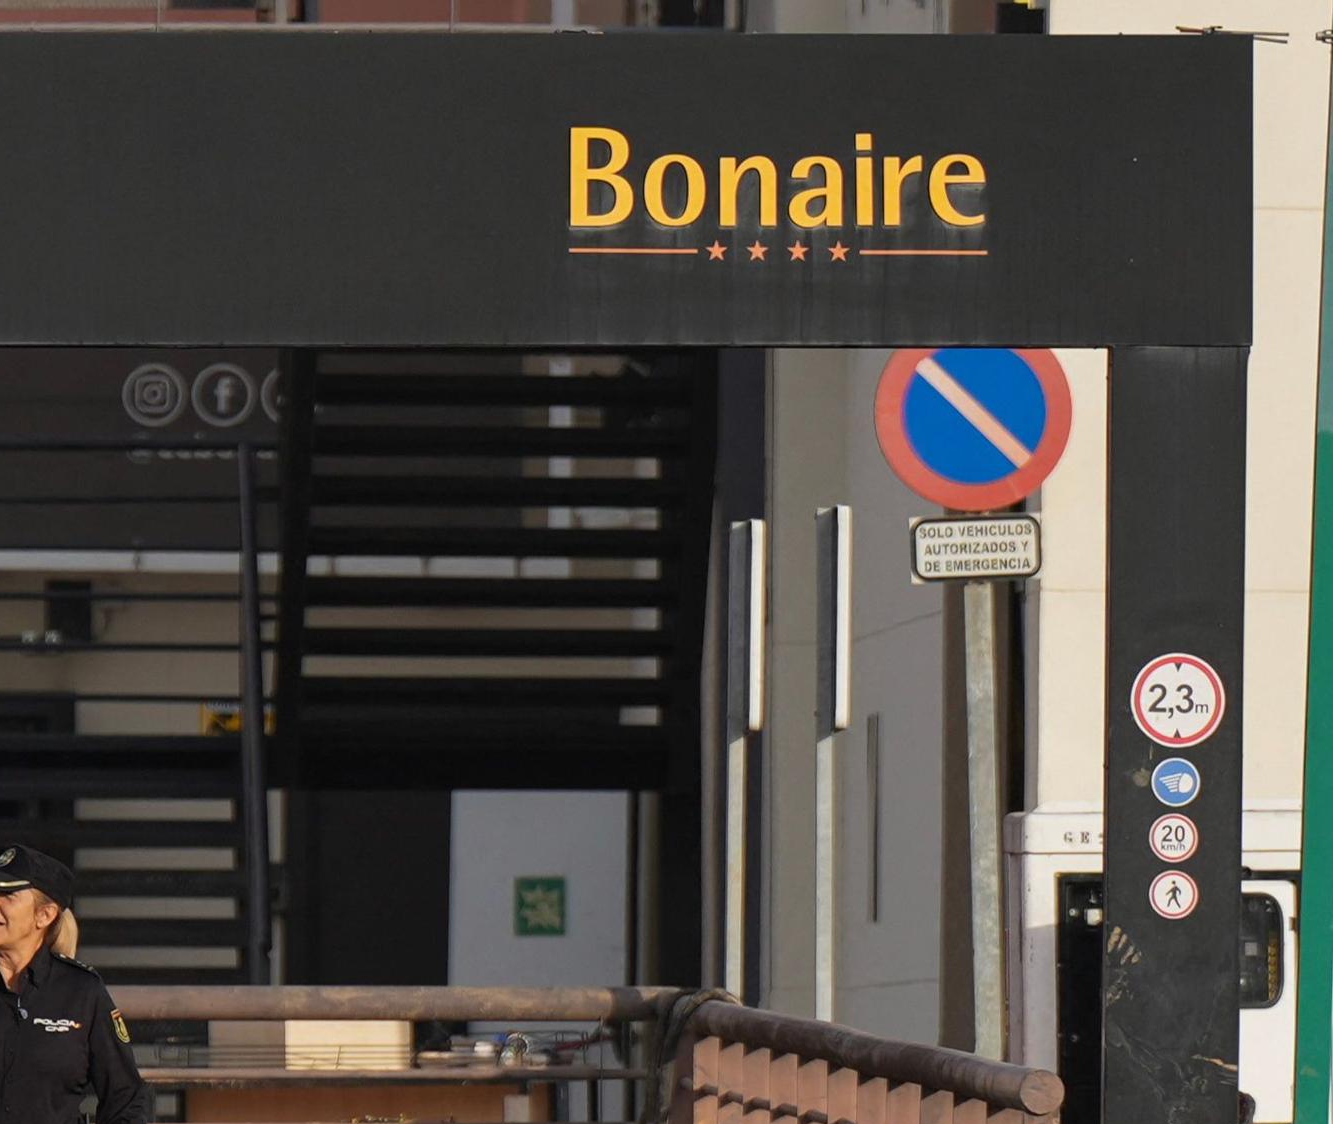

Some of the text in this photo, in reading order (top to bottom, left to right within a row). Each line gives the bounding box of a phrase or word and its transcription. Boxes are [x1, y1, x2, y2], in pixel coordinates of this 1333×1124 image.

[569, 126, 987, 229] Bonaire
[919, 523, 1032, 539] SOLO VEHICULOS
[924, 540, 1029, 556] AUTORIZADOS Y
[924, 557, 1031, 572] DE EMERGENCIA
[1160, 824, 1185, 843] 20
[1160, 842, 1186, 852] km/h
